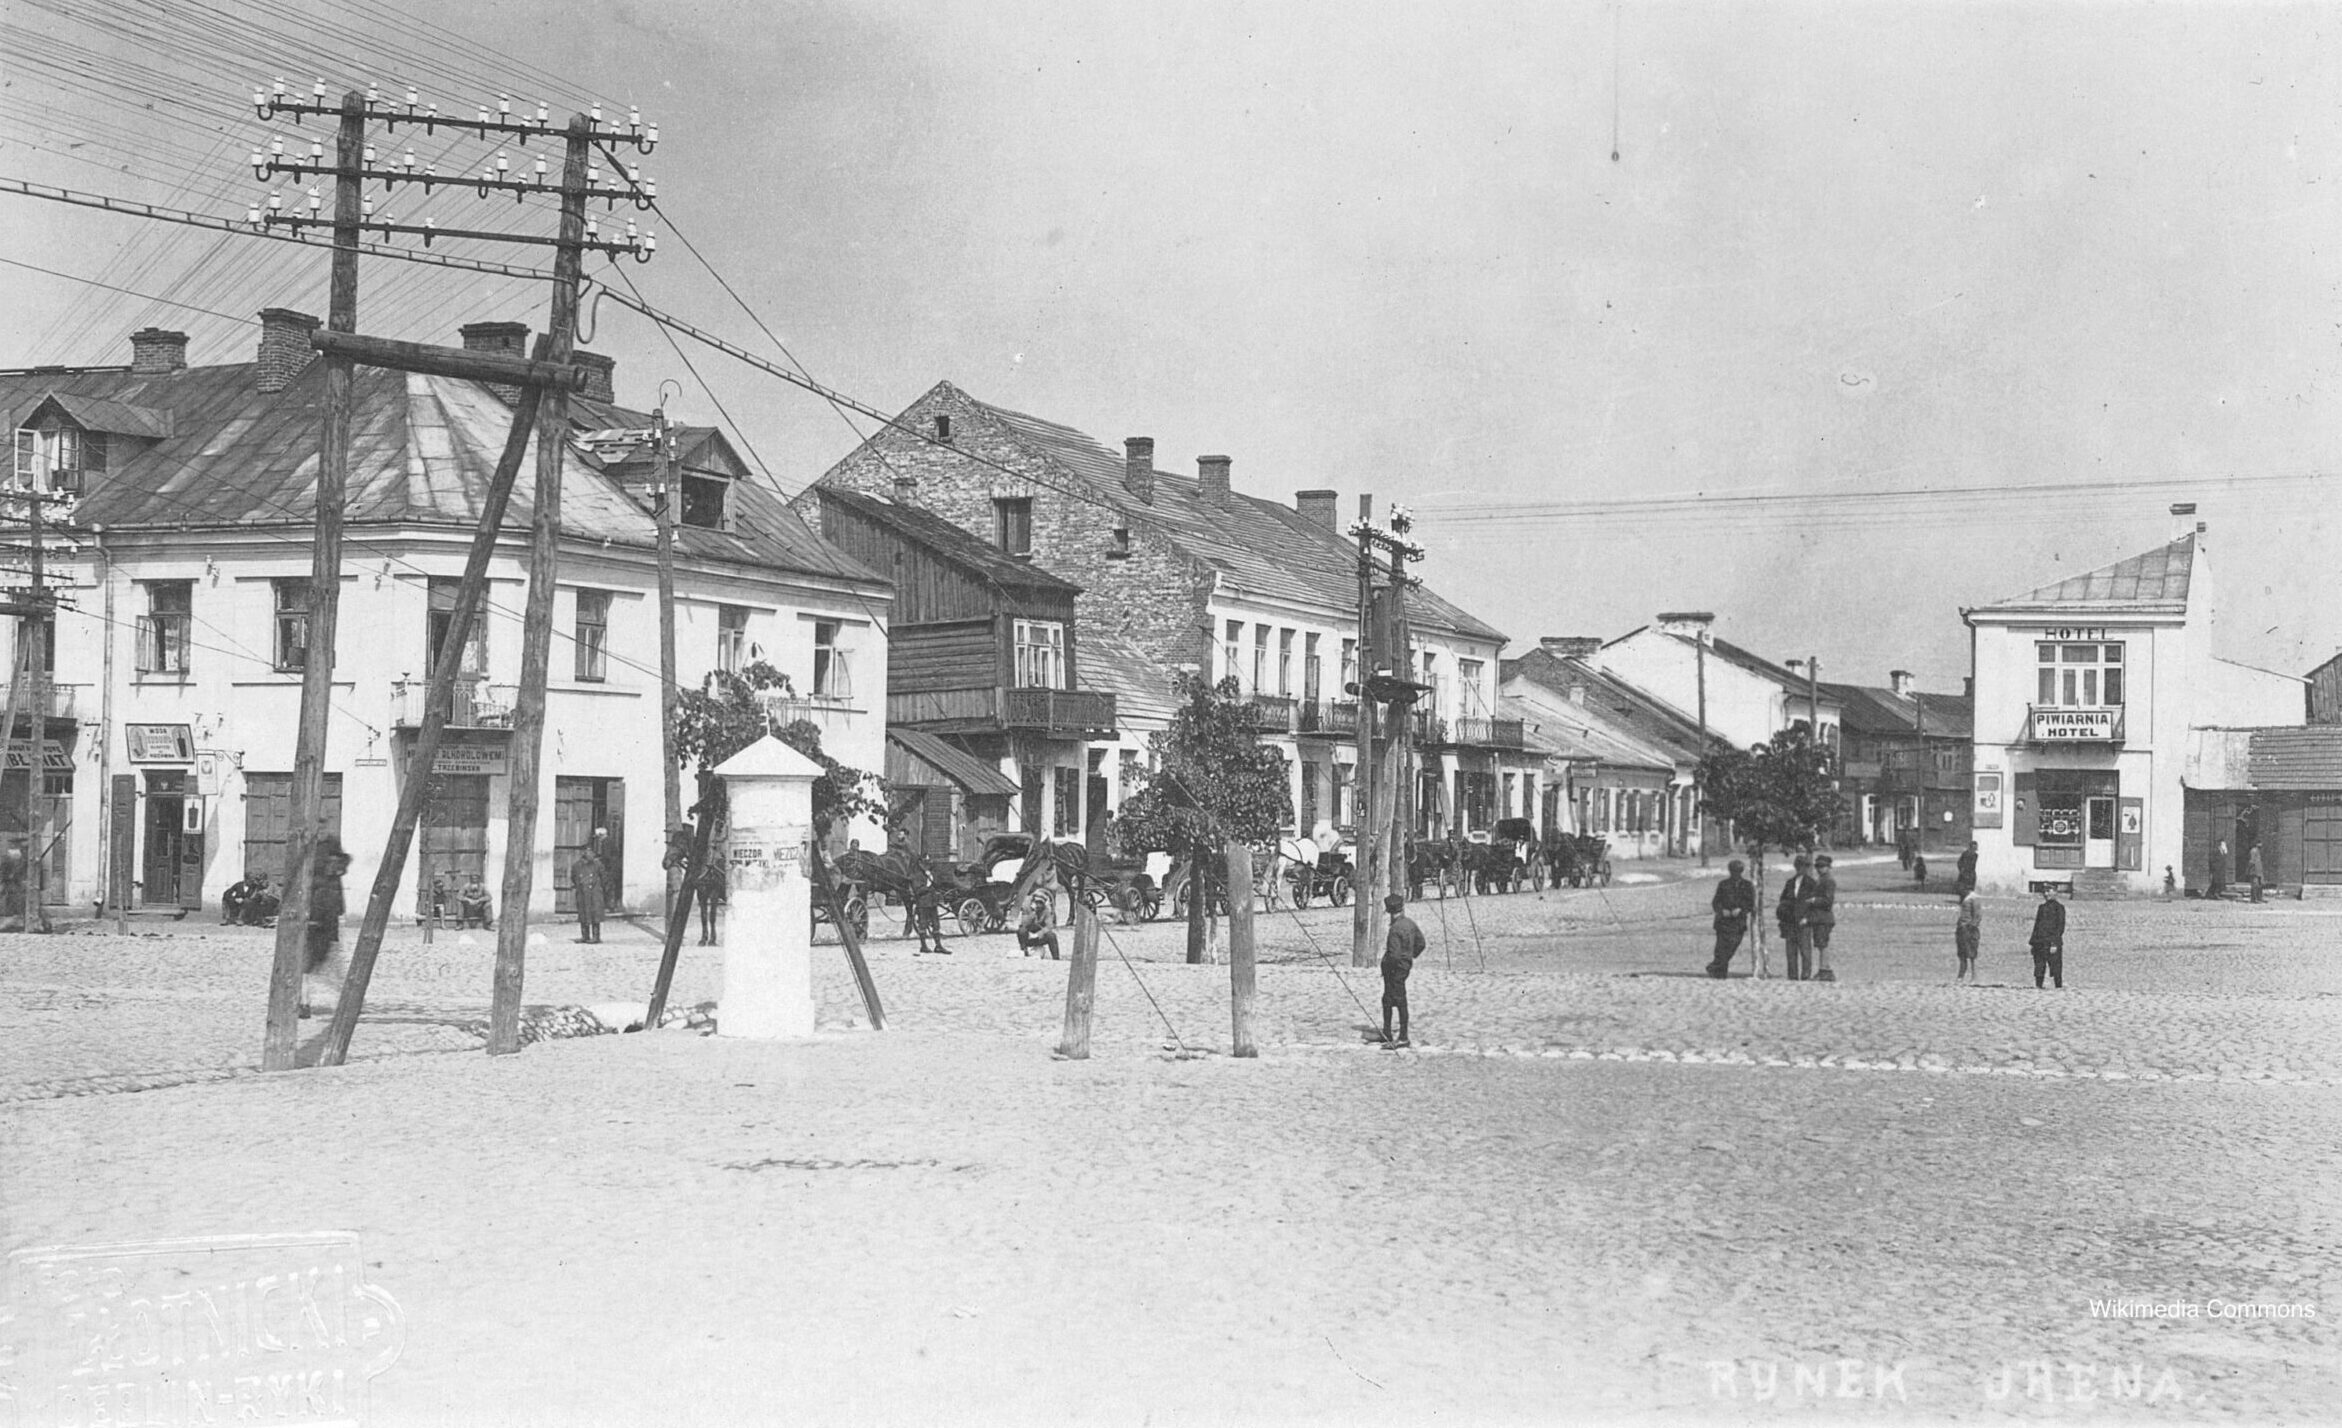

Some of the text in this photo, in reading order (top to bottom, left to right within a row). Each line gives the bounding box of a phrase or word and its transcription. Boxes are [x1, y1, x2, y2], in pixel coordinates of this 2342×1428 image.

[2045, 628, 2113, 640] HOTEL
[2036, 714, 2109, 725] PIWIARNIA
[2047, 728, 2099, 737] HOTEL
